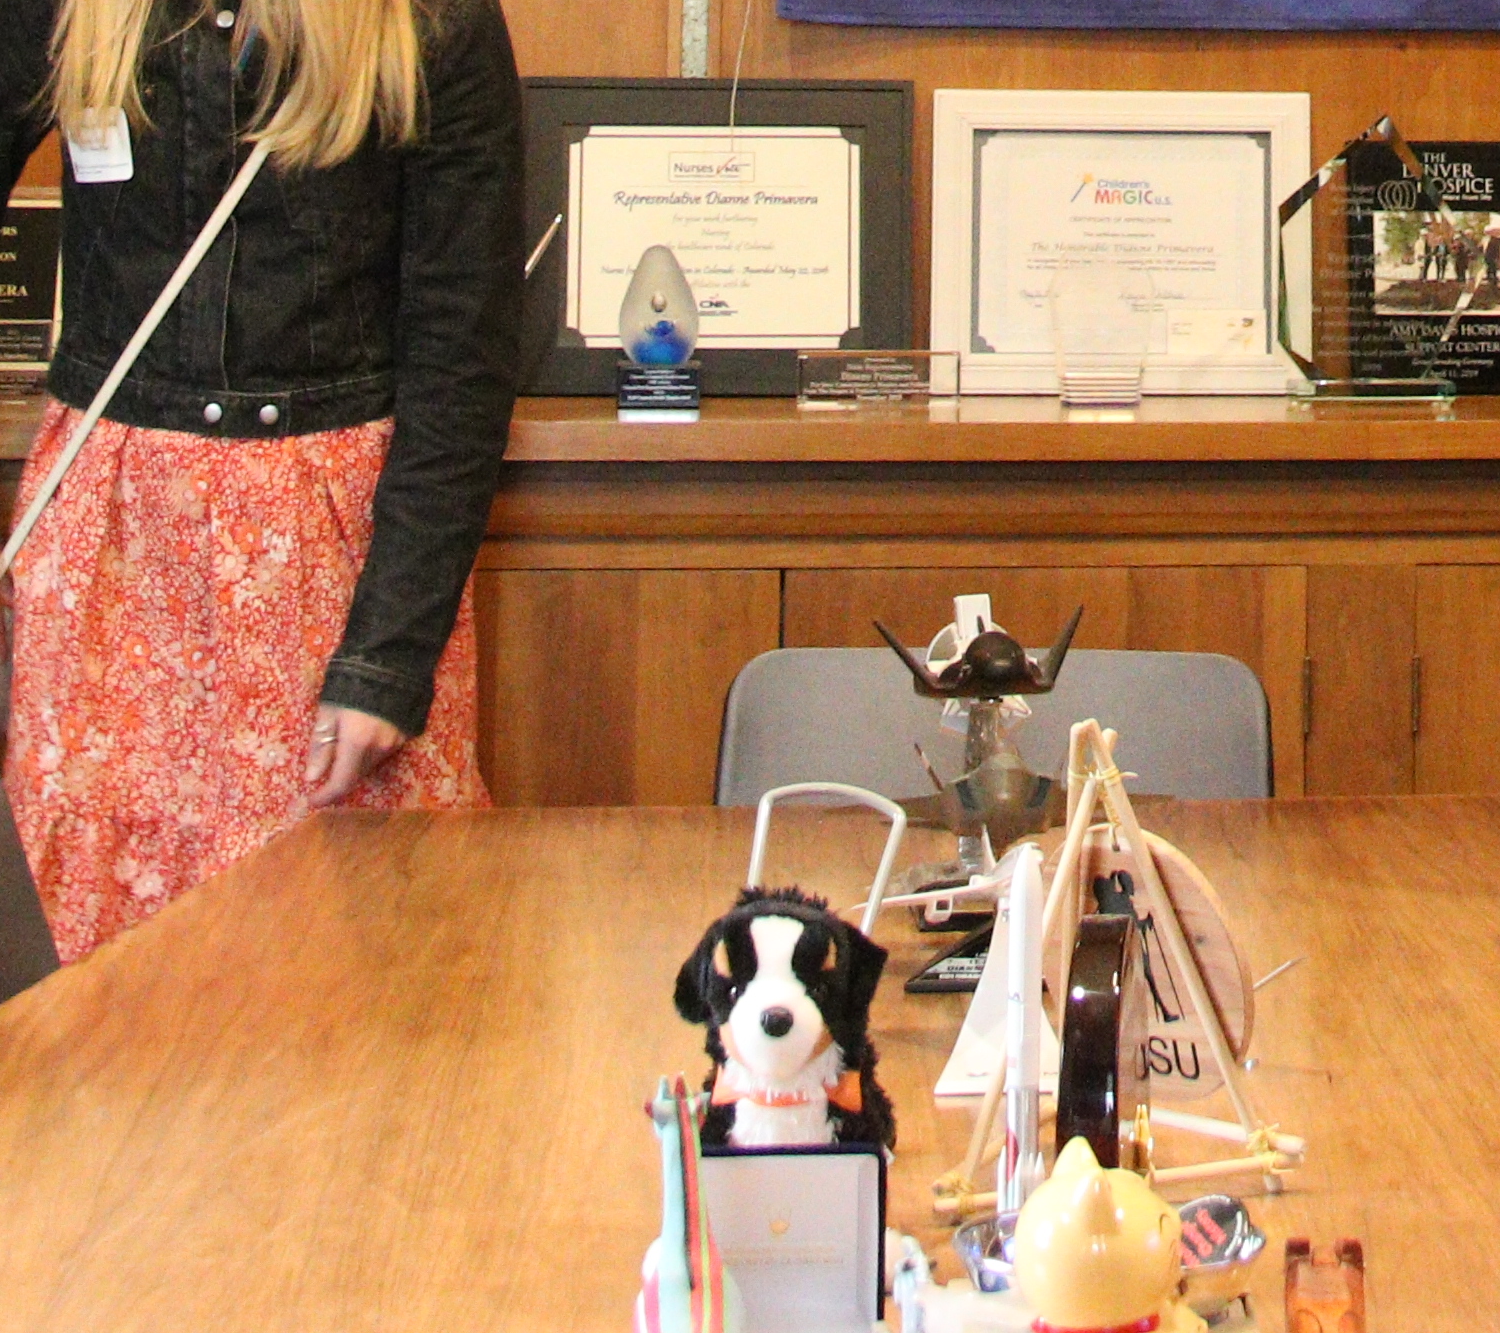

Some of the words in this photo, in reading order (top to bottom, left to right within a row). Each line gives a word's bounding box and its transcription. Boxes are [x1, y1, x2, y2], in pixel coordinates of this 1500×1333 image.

[1423, 151, 1447, 163] THE
[673, 162, 714, 174] Nurses
[1402, 163, 1475, 179] DNVER
[1097, 178, 1150, 189] Children's
[613, 190, 702, 212] Representative
[704, 190, 750, 206] Dianne
[753, 191, 819, 206] Primavera
[1094, 188, 1153, 205] MAGIC
[1455, 341, 1500, 353] CENTER
